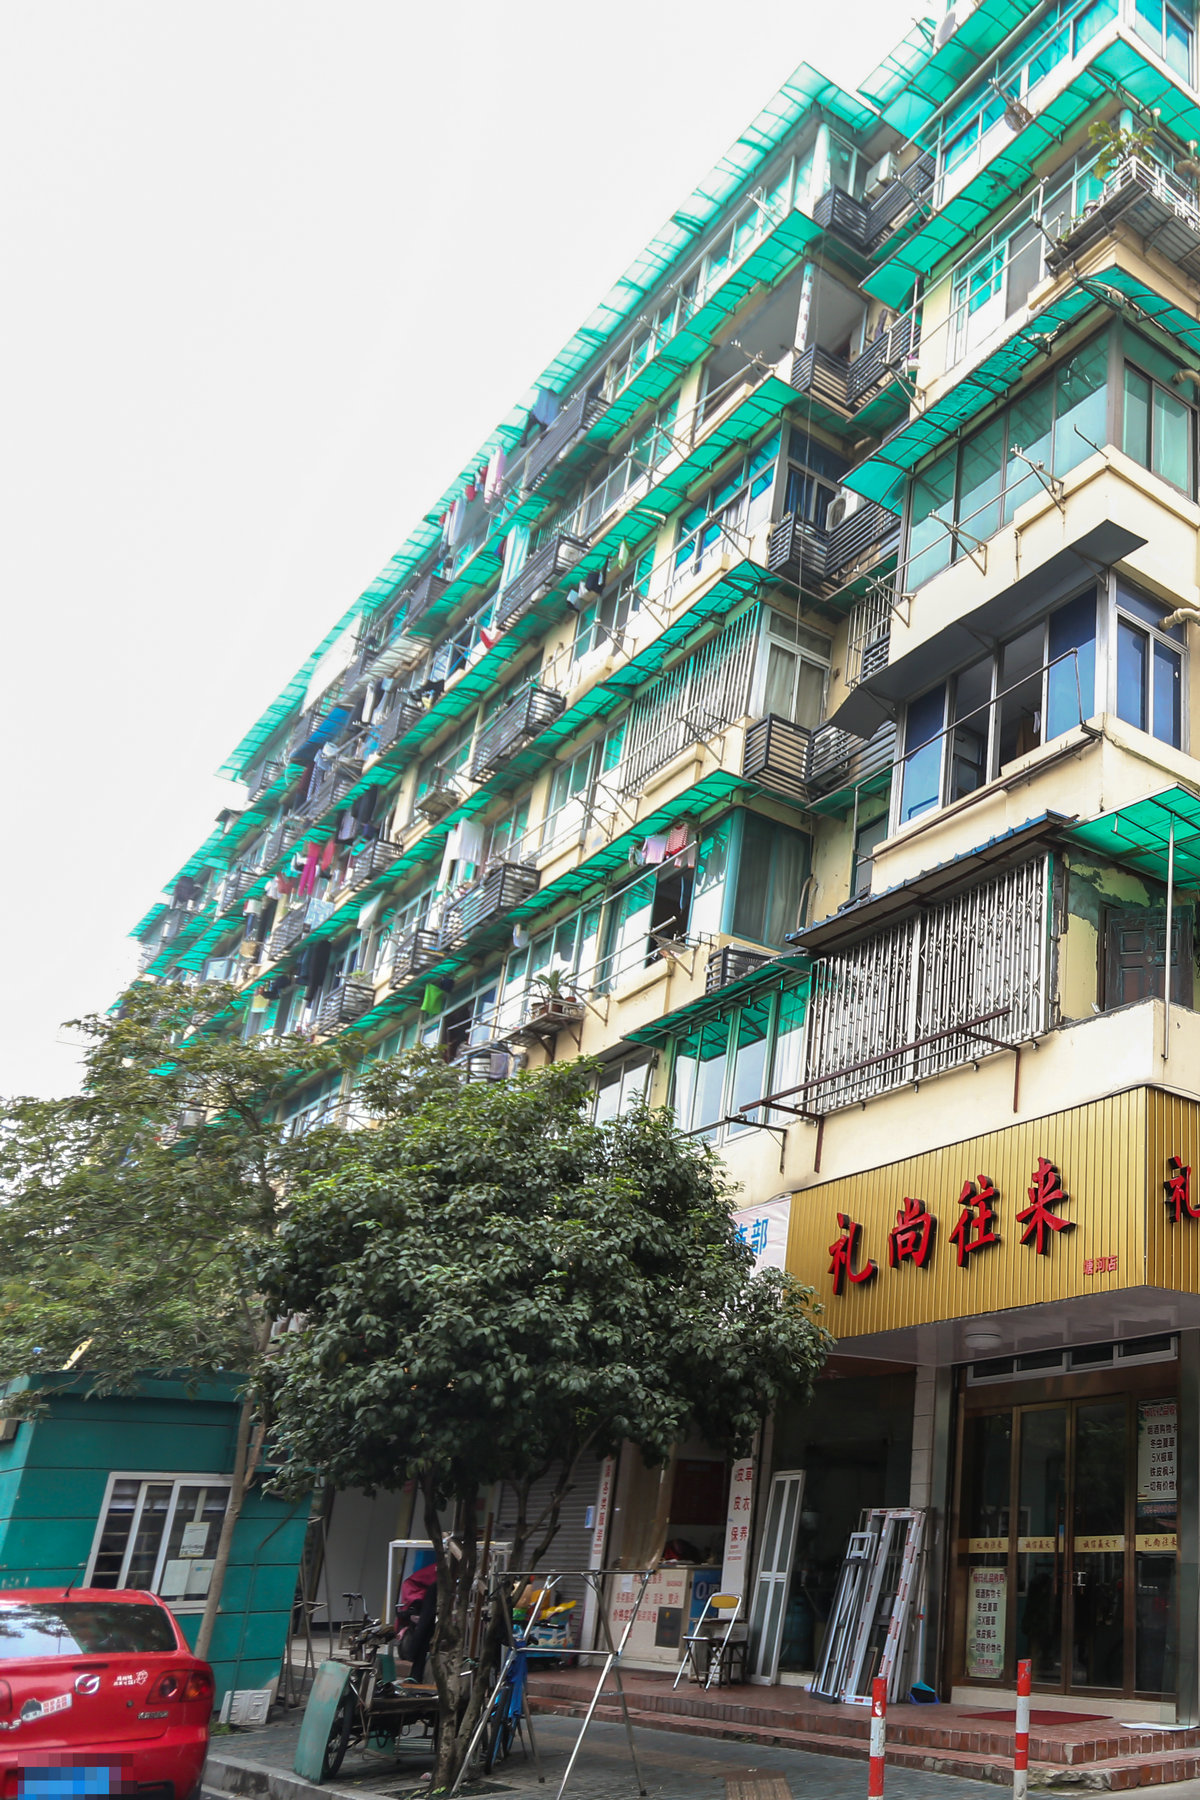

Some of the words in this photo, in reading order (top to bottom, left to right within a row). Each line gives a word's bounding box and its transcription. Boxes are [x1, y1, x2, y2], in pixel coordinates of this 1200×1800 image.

[828, 1156, 1077, 1296] 礼尚往来
[1083, 1254, 1118, 1276] 塘河店
[1150, 1437, 1175, 1449] 冬虫夏草
[1143, 1481, 1177, 1491] 一切有价物
[730, 1526, 748, 1542] 保养
